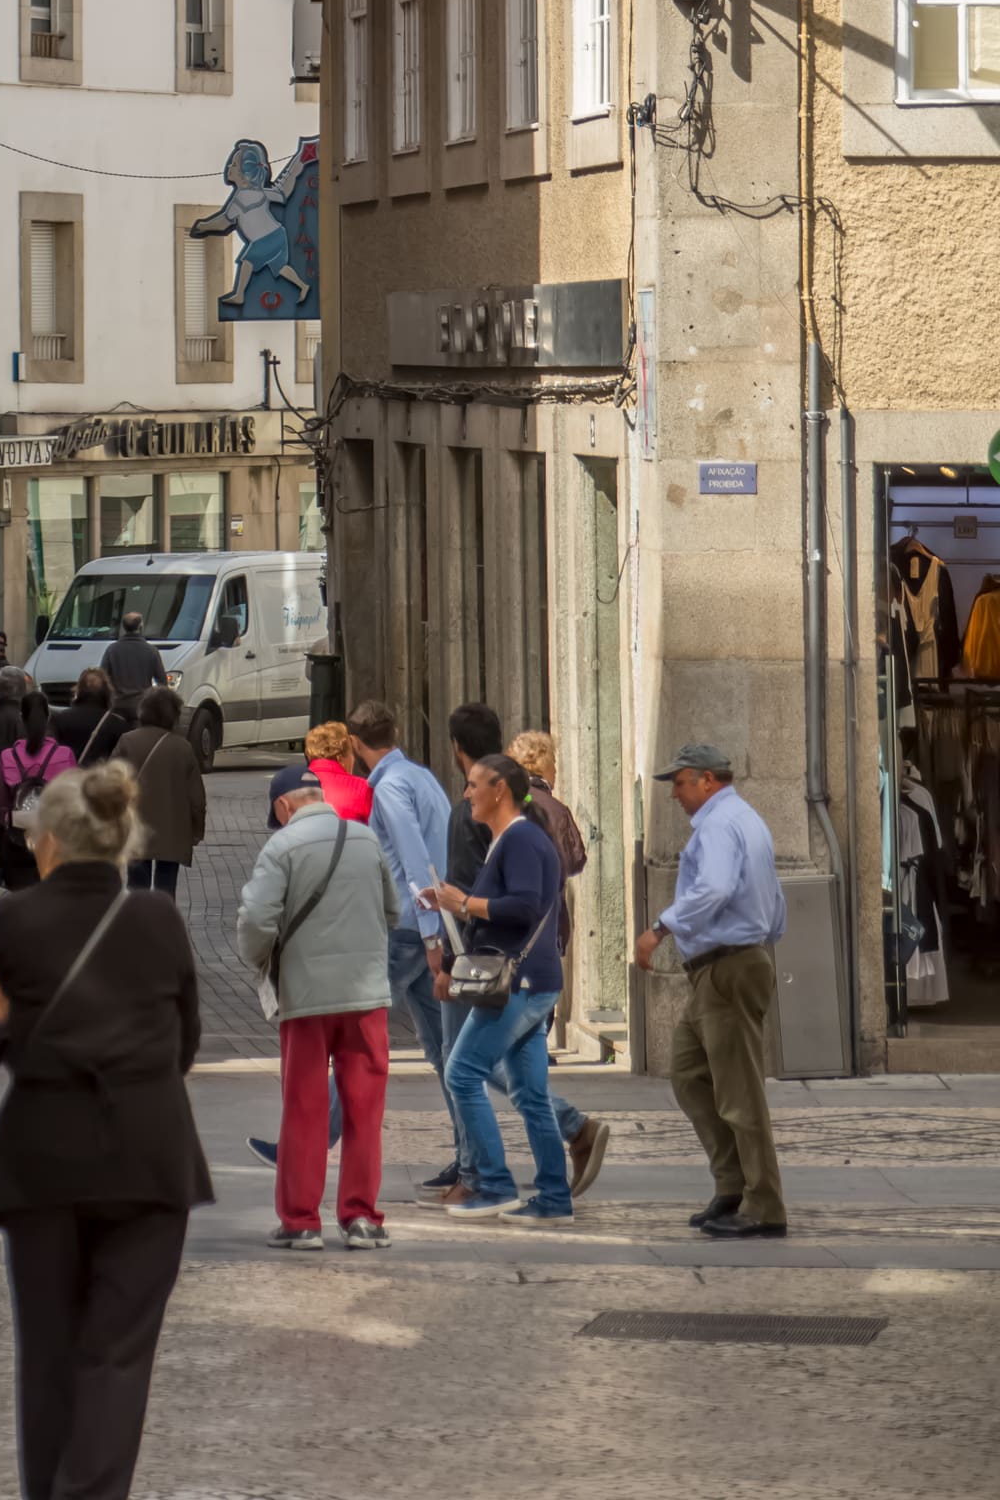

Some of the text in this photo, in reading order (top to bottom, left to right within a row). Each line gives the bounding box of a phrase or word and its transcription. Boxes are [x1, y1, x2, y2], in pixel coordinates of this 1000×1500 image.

[144, 414, 256, 457] GUIMARÃES
[708, 467, 746, 477] AFIXAÇÃO
[708, 480, 744, 488] PROIBIDA
